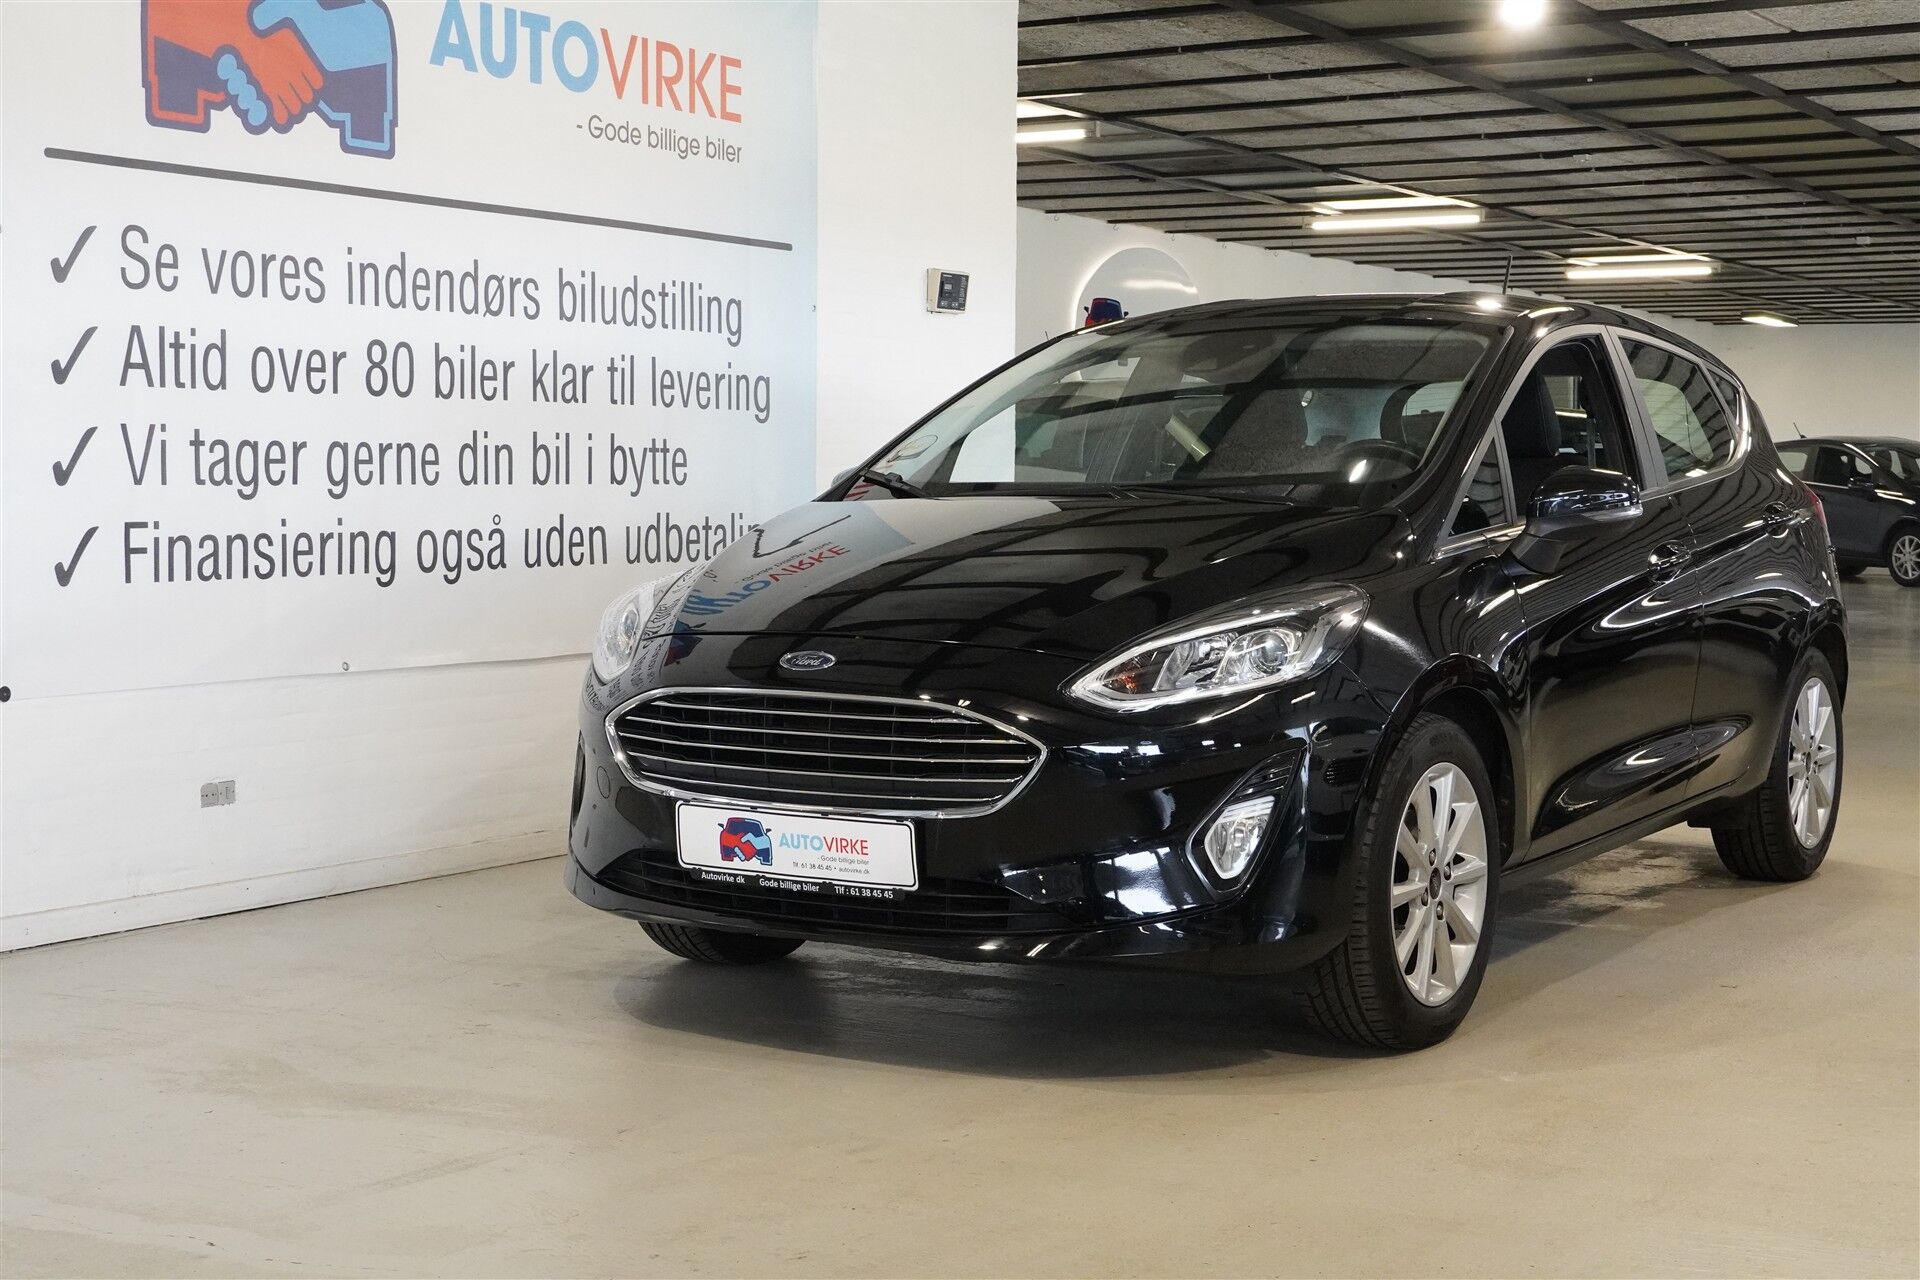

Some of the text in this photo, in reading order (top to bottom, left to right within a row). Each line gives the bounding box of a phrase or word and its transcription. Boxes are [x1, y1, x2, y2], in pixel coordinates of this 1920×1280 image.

[430, 0, 742, 124] AUTOVIRKE
[587, 114, 642, 147] Gode
[647, 124, 701, 161] billige
[705, 135, 743, 164] biler
[119, 224, 742, 348] Se vores indendørs biludstilling
[119, 324, 771, 424] Altid over 80 biler klar til levering
[119, 422, 688, 501] Vi tager gerne din bil i bytte
[123, 517, 397, 589] Finansiering
[416, 513, 506, 586] også
[523, 525, 608, 571] uden
[779, 831, 870, 856] AUTOVIRKE
[820, 854, 838, 863] Gode
[701, 871, 735, 883] Autovirke
[736, 875, 745, 884] dk
[759, 878, 779, 888] Gode
[779, 880, 801, 891] billige
[802, 881, 820, 892] biler
[850, 887, 860, 896] 61
[861, 888, 871, 897] 38
[872, 889, 882, 898] 45
[883, 890, 894, 899] 45
